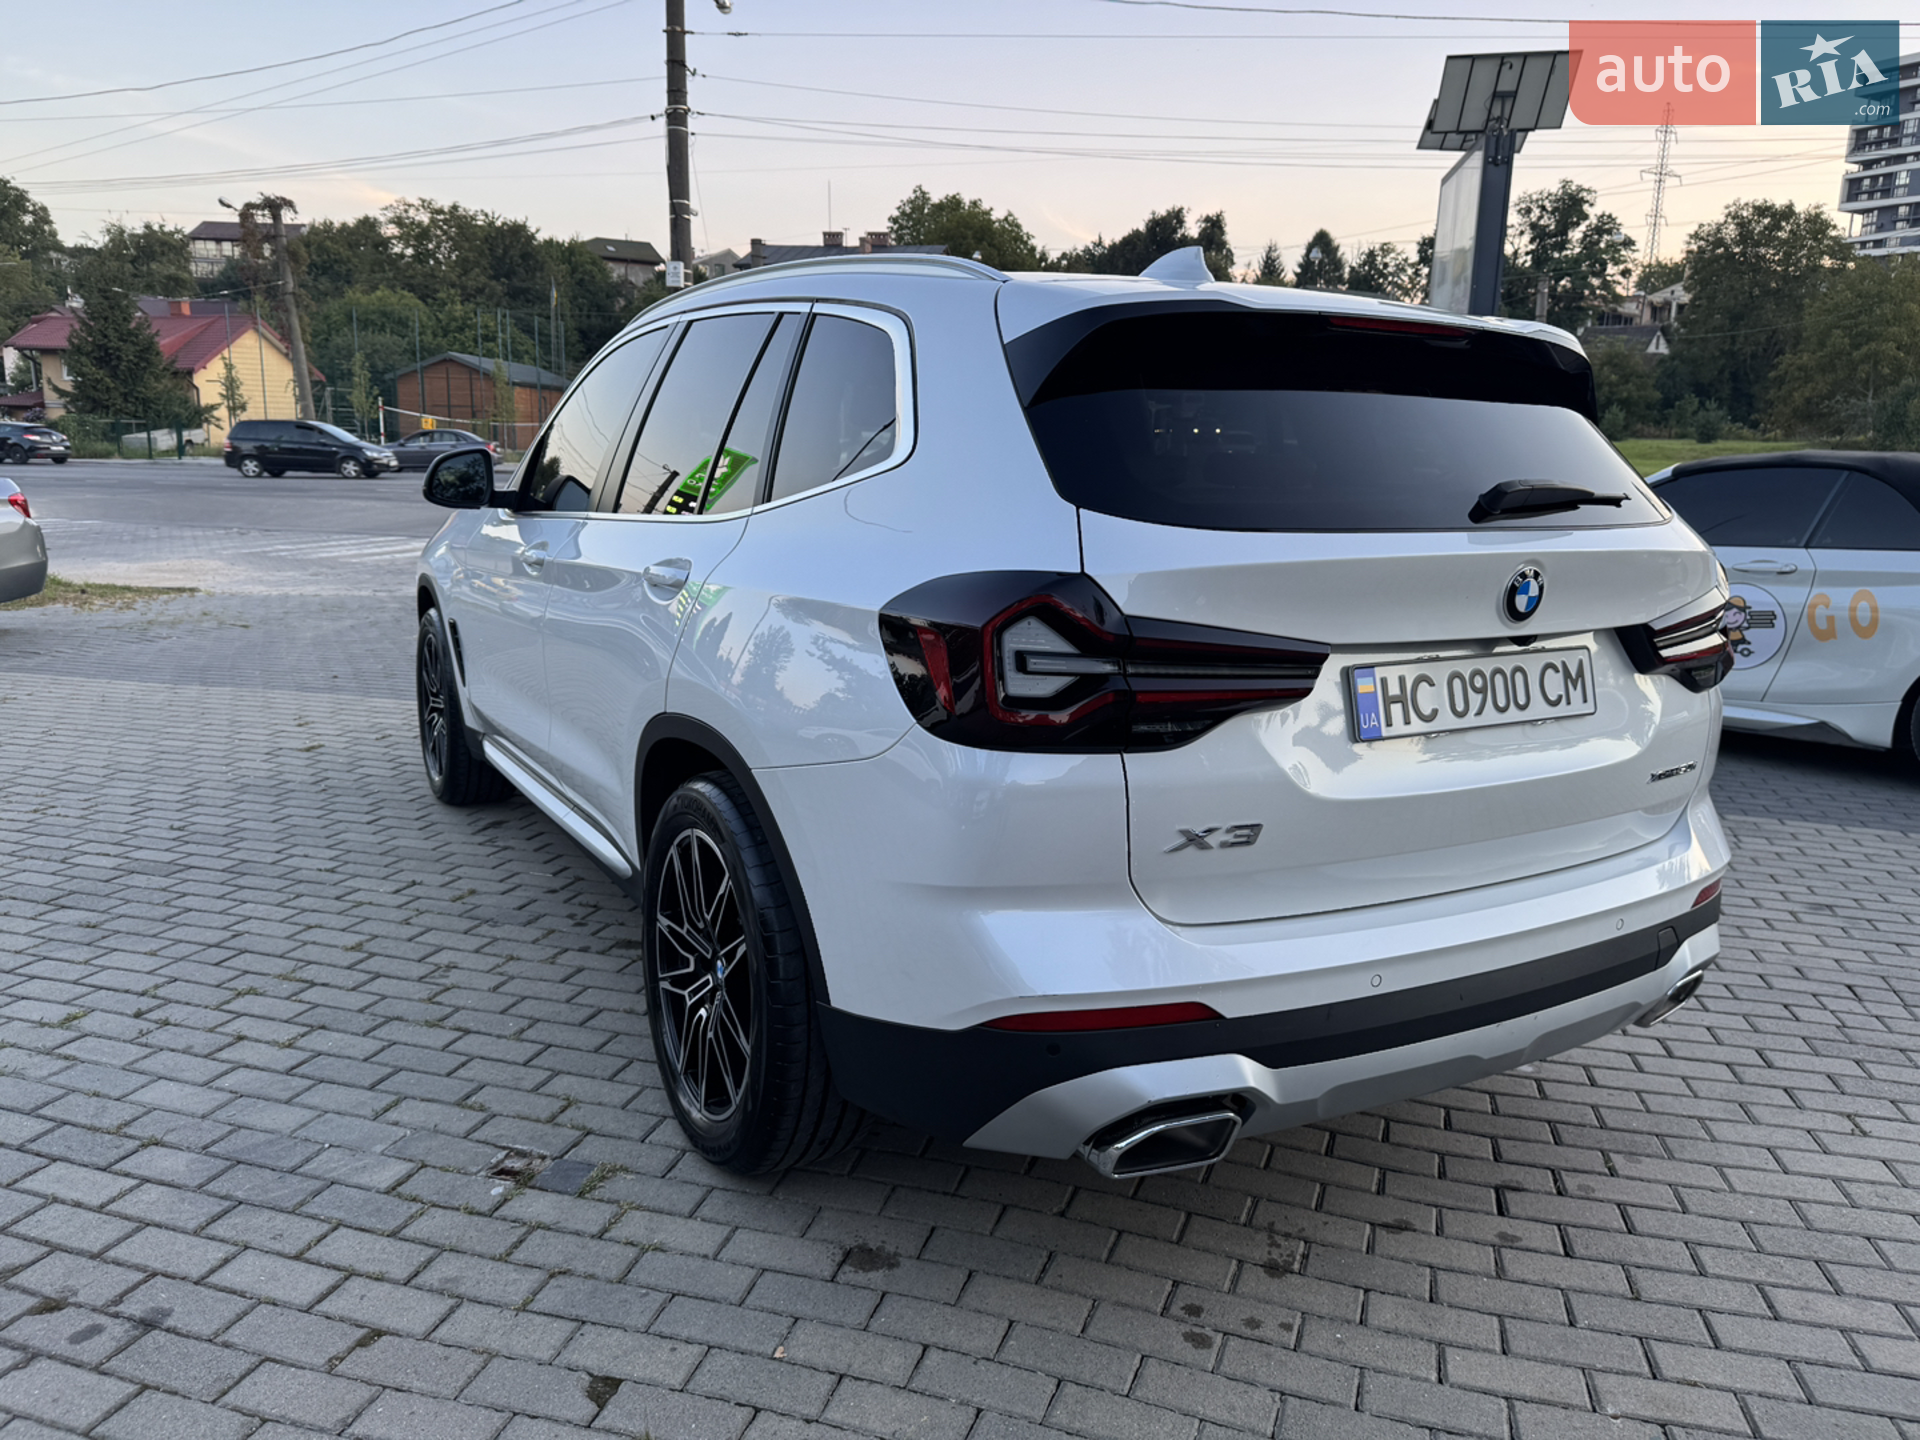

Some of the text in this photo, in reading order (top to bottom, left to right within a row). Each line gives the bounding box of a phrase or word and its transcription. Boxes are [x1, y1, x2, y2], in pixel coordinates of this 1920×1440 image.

[1513, 568, 1544, 588] BMW
[1807, 589, 1880, 643] GO
[1380, 656, 1588, 728] HC 0900 CM
[1360, 712, 1379, 729] UA
[1163, 822, 1264, 854] X3
